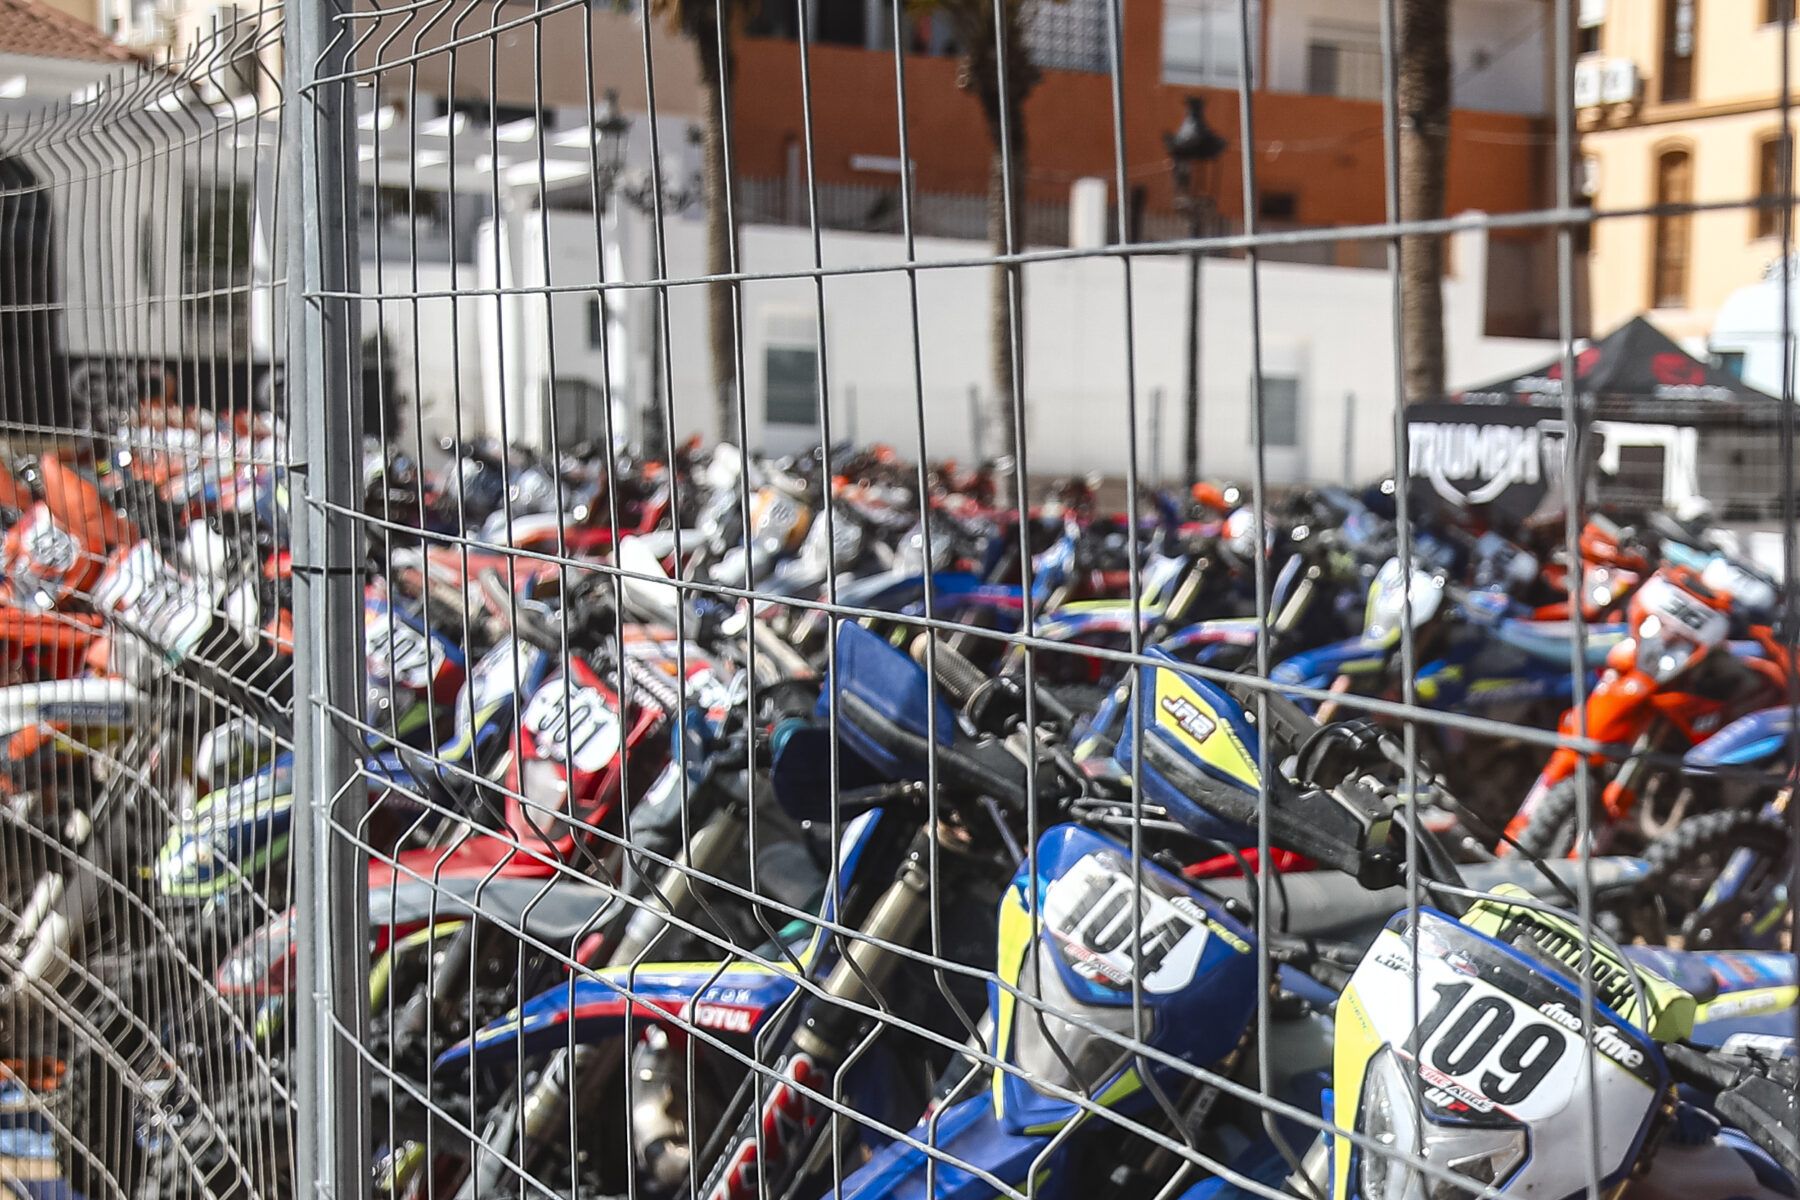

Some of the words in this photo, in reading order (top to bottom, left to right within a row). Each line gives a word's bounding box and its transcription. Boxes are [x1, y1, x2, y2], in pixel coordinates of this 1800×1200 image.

[1408, 421, 1541, 495] TRIUMPH
[1058, 873, 1195, 978] 104
[678, 1004, 751, 1033] MOTUL
[1402, 982, 1567, 1106] 109
[1538, 1001, 1582, 1032] rfme
